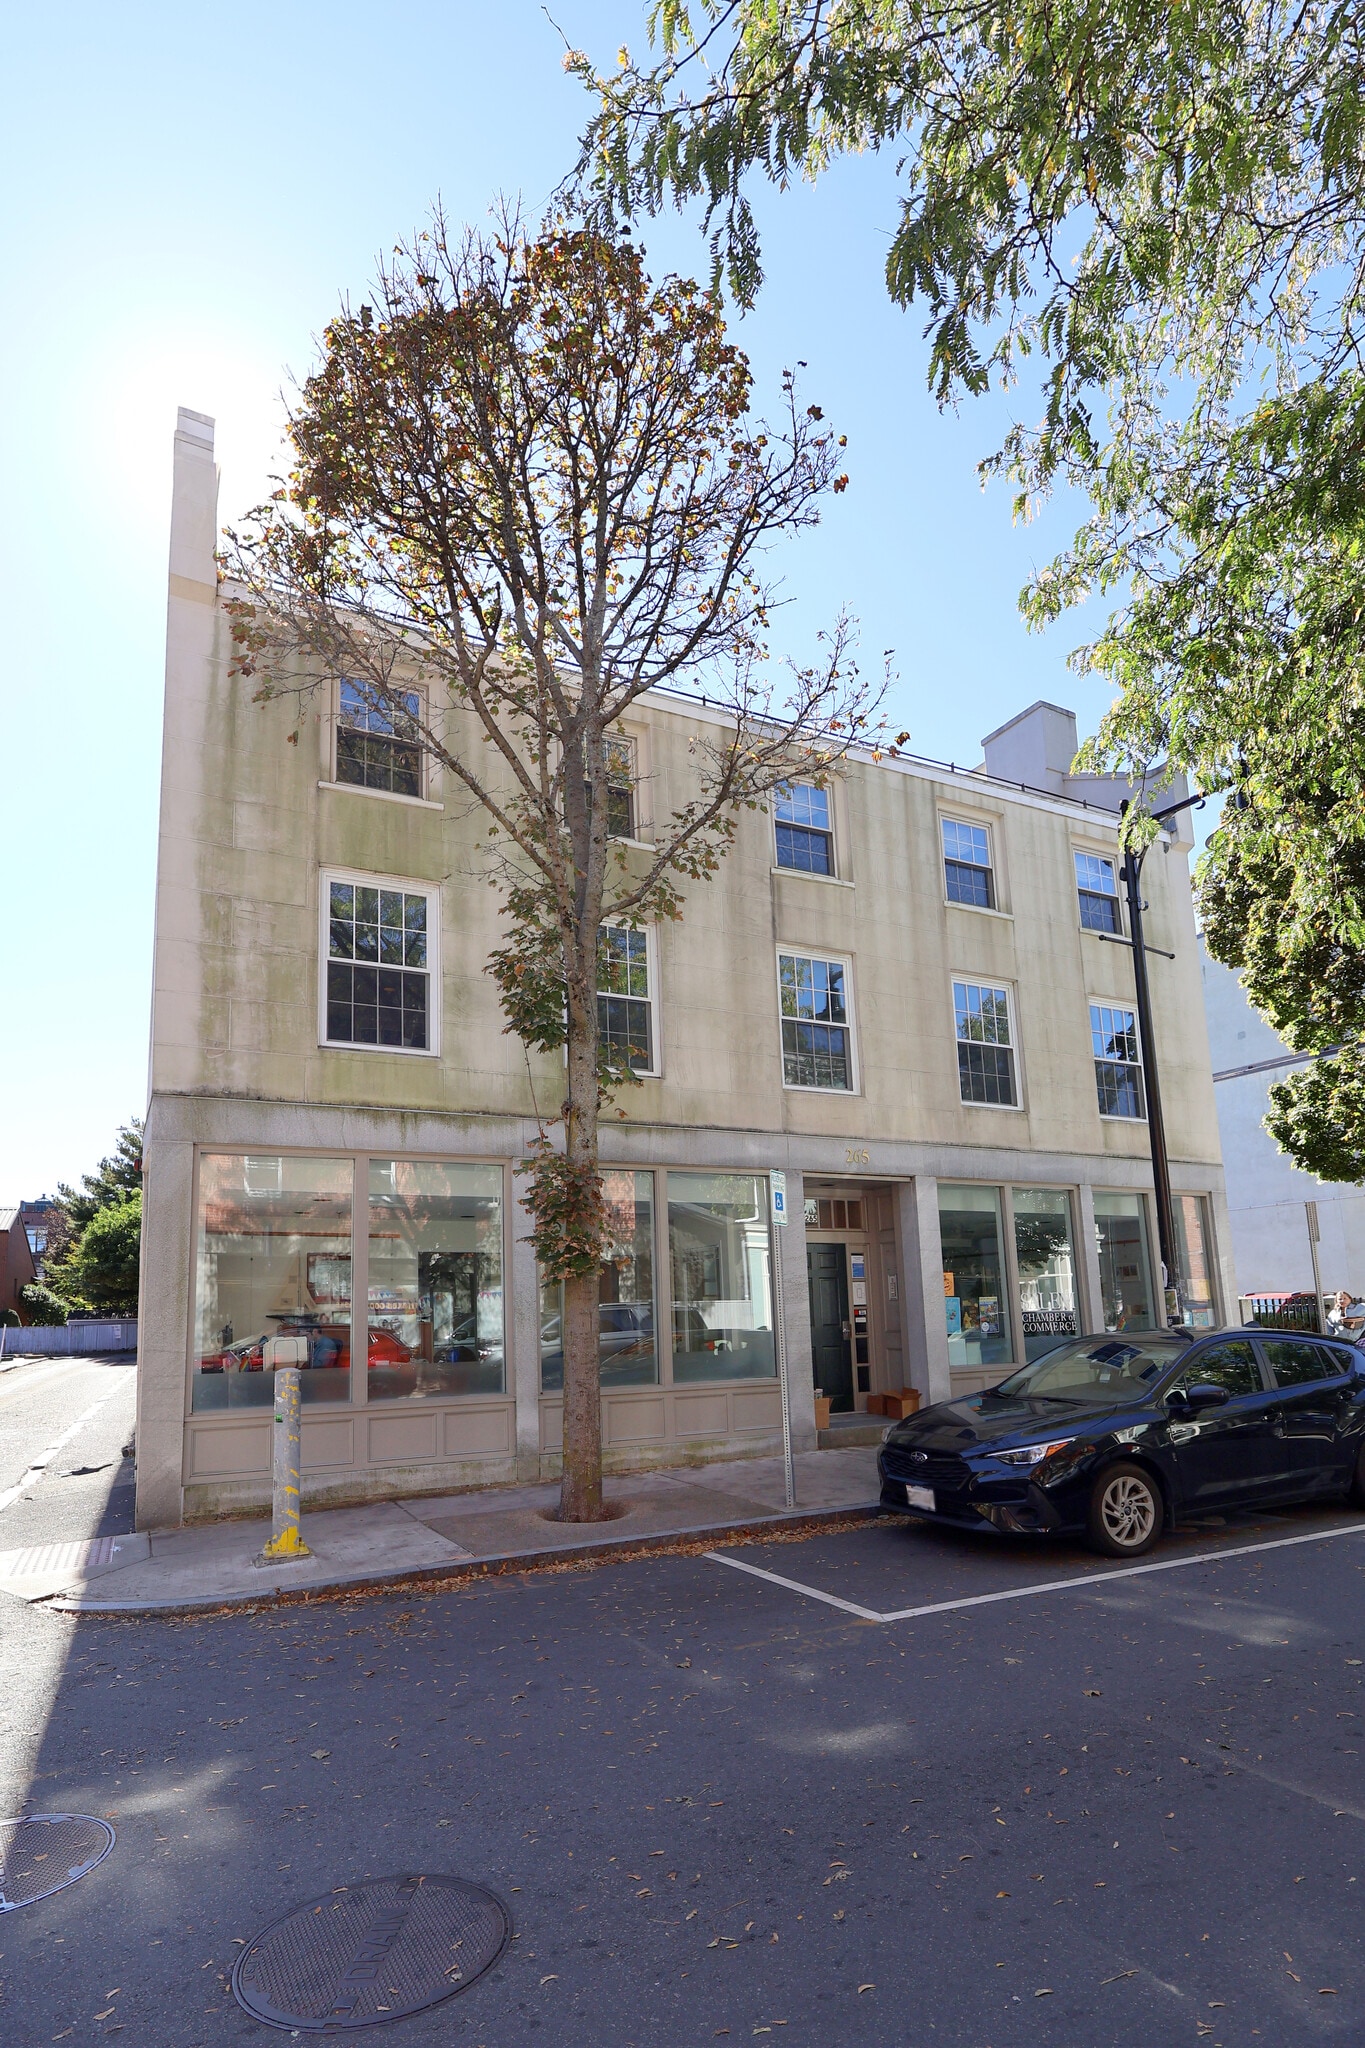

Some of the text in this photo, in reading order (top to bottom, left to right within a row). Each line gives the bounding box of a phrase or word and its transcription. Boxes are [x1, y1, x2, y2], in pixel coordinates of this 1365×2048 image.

[845, 1148, 870, 1165] 265
[1020, 1291, 1076, 1311] SALEM
[1021, 1311, 1076, 1323] CHAMBER of
[1023, 1321, 1078, 1333] COMMERCE
[343, 1907, 411, 1980] DRAIN
